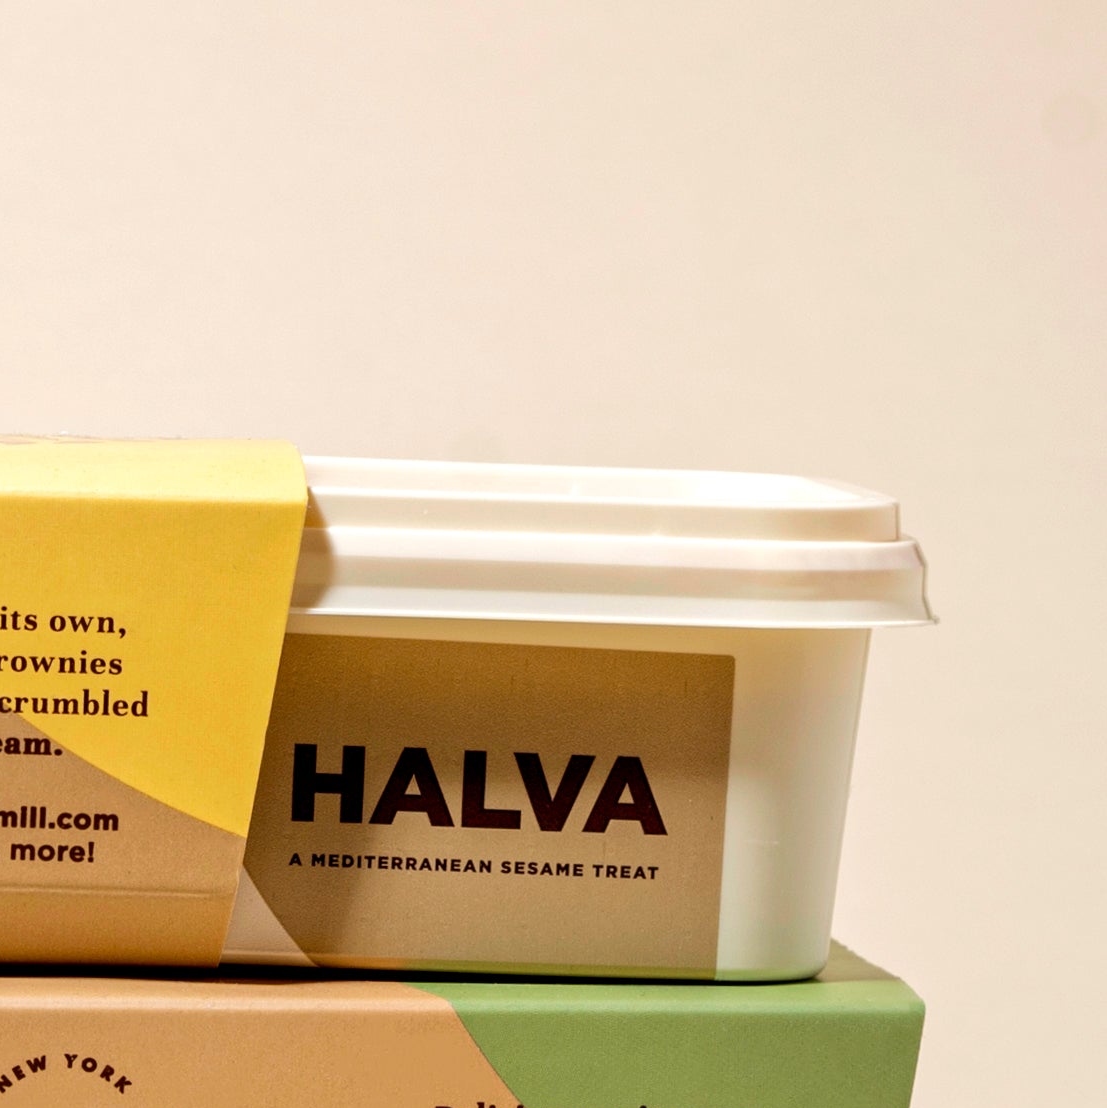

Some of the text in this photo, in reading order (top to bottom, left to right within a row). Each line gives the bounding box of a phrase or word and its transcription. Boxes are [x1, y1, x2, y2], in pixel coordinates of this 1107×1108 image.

[0, 605, 38, 631] its
[49, 615, 126, 639] own,
[290, 742, 668, 836] HALVA
[10, 841, 95, 863] more!
[288, 852, 659, 880] A MEDITERRANEAN SESAME TREAT
[64, 1053, 133, 1095] YORK
